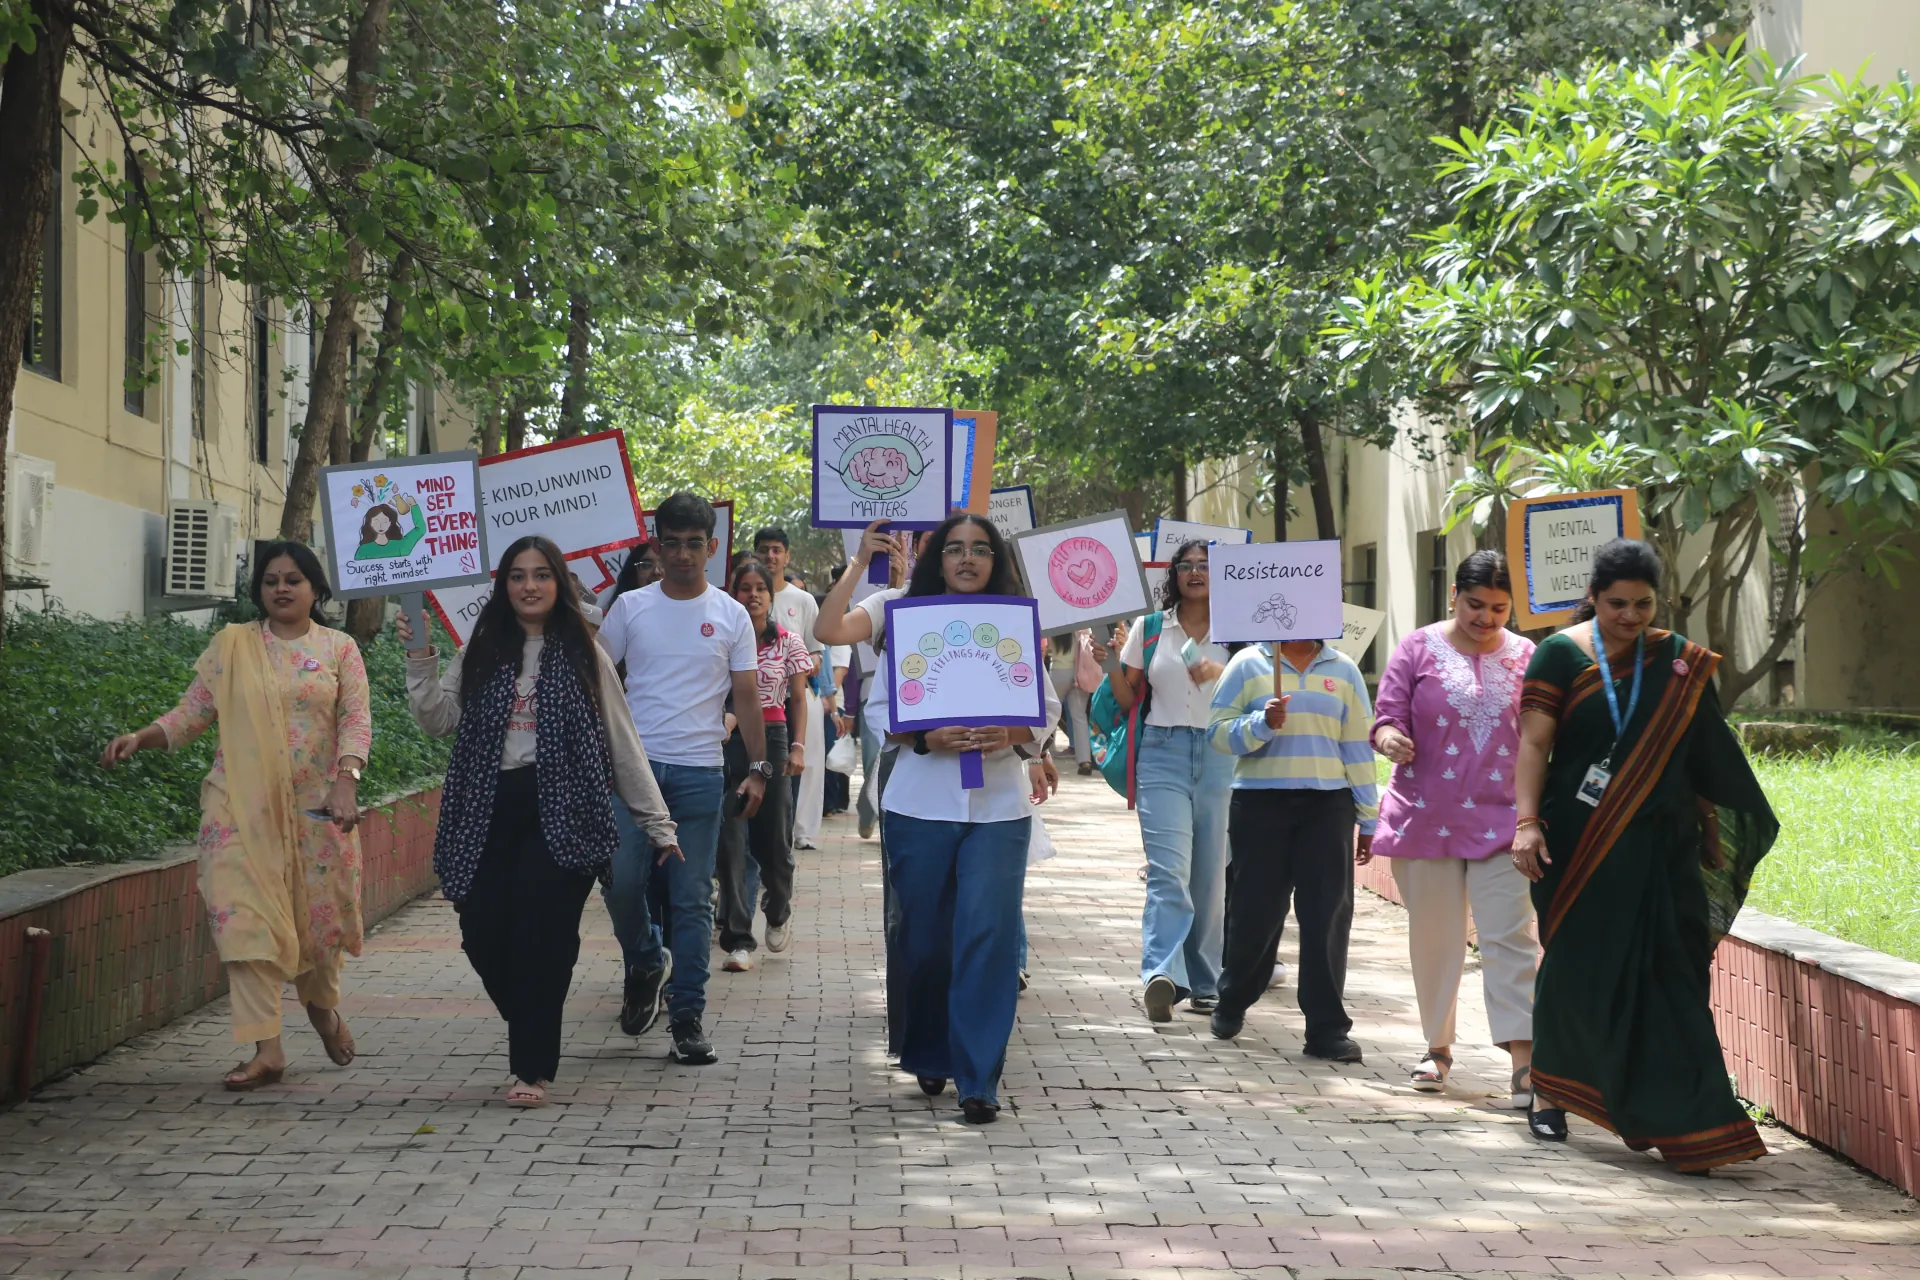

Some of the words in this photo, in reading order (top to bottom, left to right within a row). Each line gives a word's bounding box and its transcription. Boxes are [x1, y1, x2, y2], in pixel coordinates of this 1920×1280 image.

[833, 416, 882, 451] MENTAL
[885, 418, 934, 452] HEALTH
[416, 475, 455, 494] MIND
[426, 492, 455, 511] SET
[491, 506, 540, 528] YOUR
[543, 492, 598, 517] MIND!
[851, 501, 908, 517] MATTERS
[988, 497, 1022, 509] ONGER
[426, 511, 477, 533] EVERY
[1548, 519, 1597, 539] MENTAL
[425, 531, 478, 556] THING
[346, 561, 384, 574] Success
[389, 560, 412, 570] starts
[416, 555, 433, 567] with
[1544, 546, 1589, 566] HEALTH
[365, 572, 387, 586] right
[392, 567, 429, 580] mindset
[1224, 561, 1324, 580] Resistance
[1075, 596, 1091, 605] NOT
[1092, 576, 1115, 604] SELFISH
[1550, 572, 1590, 592] WEALT
[931, 648, 973, 674] FEELINGS
[975, 649, 991, 661] ARE
